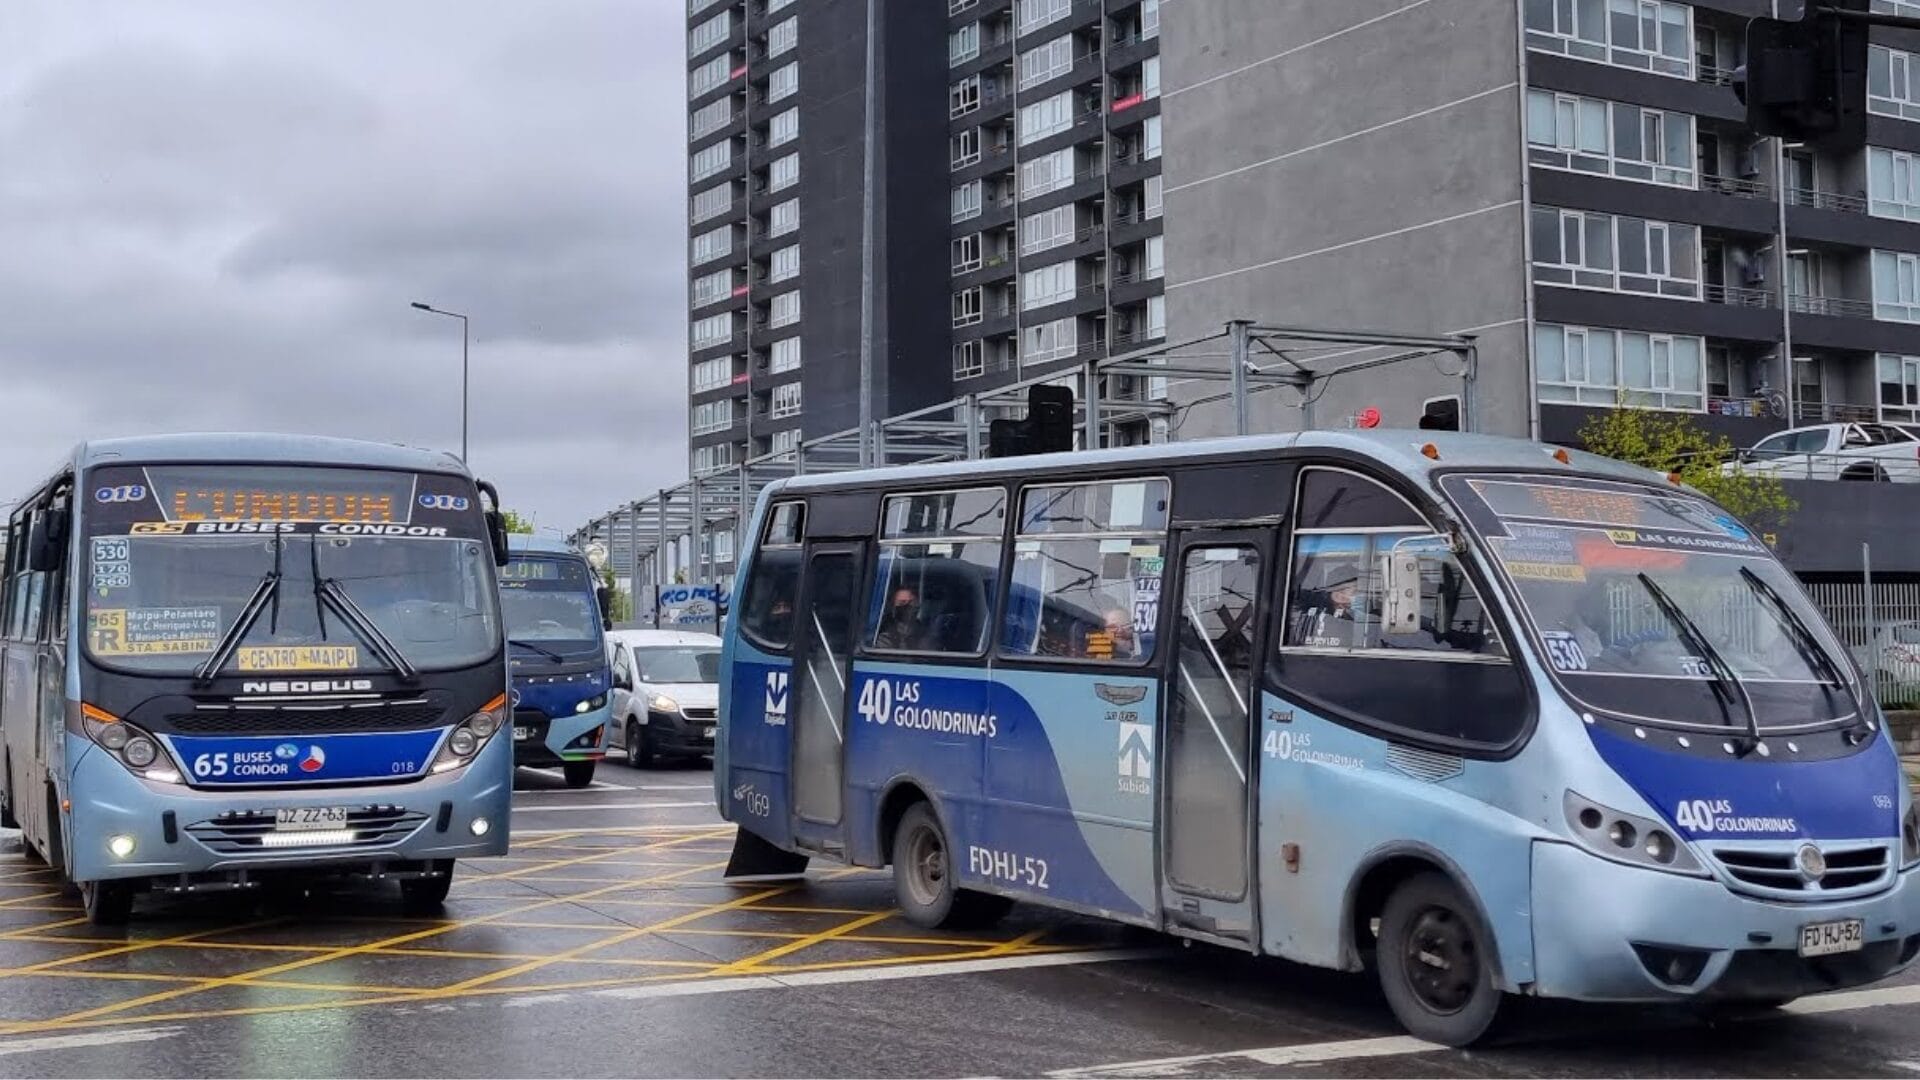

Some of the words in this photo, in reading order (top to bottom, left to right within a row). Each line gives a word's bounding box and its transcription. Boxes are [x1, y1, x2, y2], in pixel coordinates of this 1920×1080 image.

[95, 486, 146, 503] 018
[419, 494, 469, 511] 018
[133, 523, 183, 532] 65
[196, 523, 297, 533] BUSES
[320, 524, 448, 536] CONDOR
[1637, 534, 1666, 544] LAS
[96, 546, 127, 560] 530
[97, 565, 128, 574] 170
[1139, 578, 1161, 590] 170
[1133, 602, 1158, 632] 530
[98, 629, 119, 652] R
[128, 643, 159, 653] STA.
[162, 641, 214, 652] SABINA
[251, 648, 297, 668] CENTRO
[1548, 639, 1588, 670] 530
[243, 680, 372, 692] NEOBUS
[858, 679, 892, 724] 40
[896, 680, 920, 704] LAS
[894, 706, 997, 738] GOLONDRINAS
[1263, 730, 1292, 760] 40
[1292, 732, 1312, 746] LAS
[194, 753, 228, 777] 65
[234, 751, 273, 764] BUSES
[233, 763, 289, 776] CONDOR
[391, 761, 415, 773] 018
[1118, 779, 1151, 795] Subida
[747, 791, 769, 817] 069
[1676, 800, 1714, 832] 40
[1708, 800, 1732, 814] LAS
[1716, 816, 1796, 833] GOLONDRINAS
[969, 845, 1049, 890] FDHJ-52
